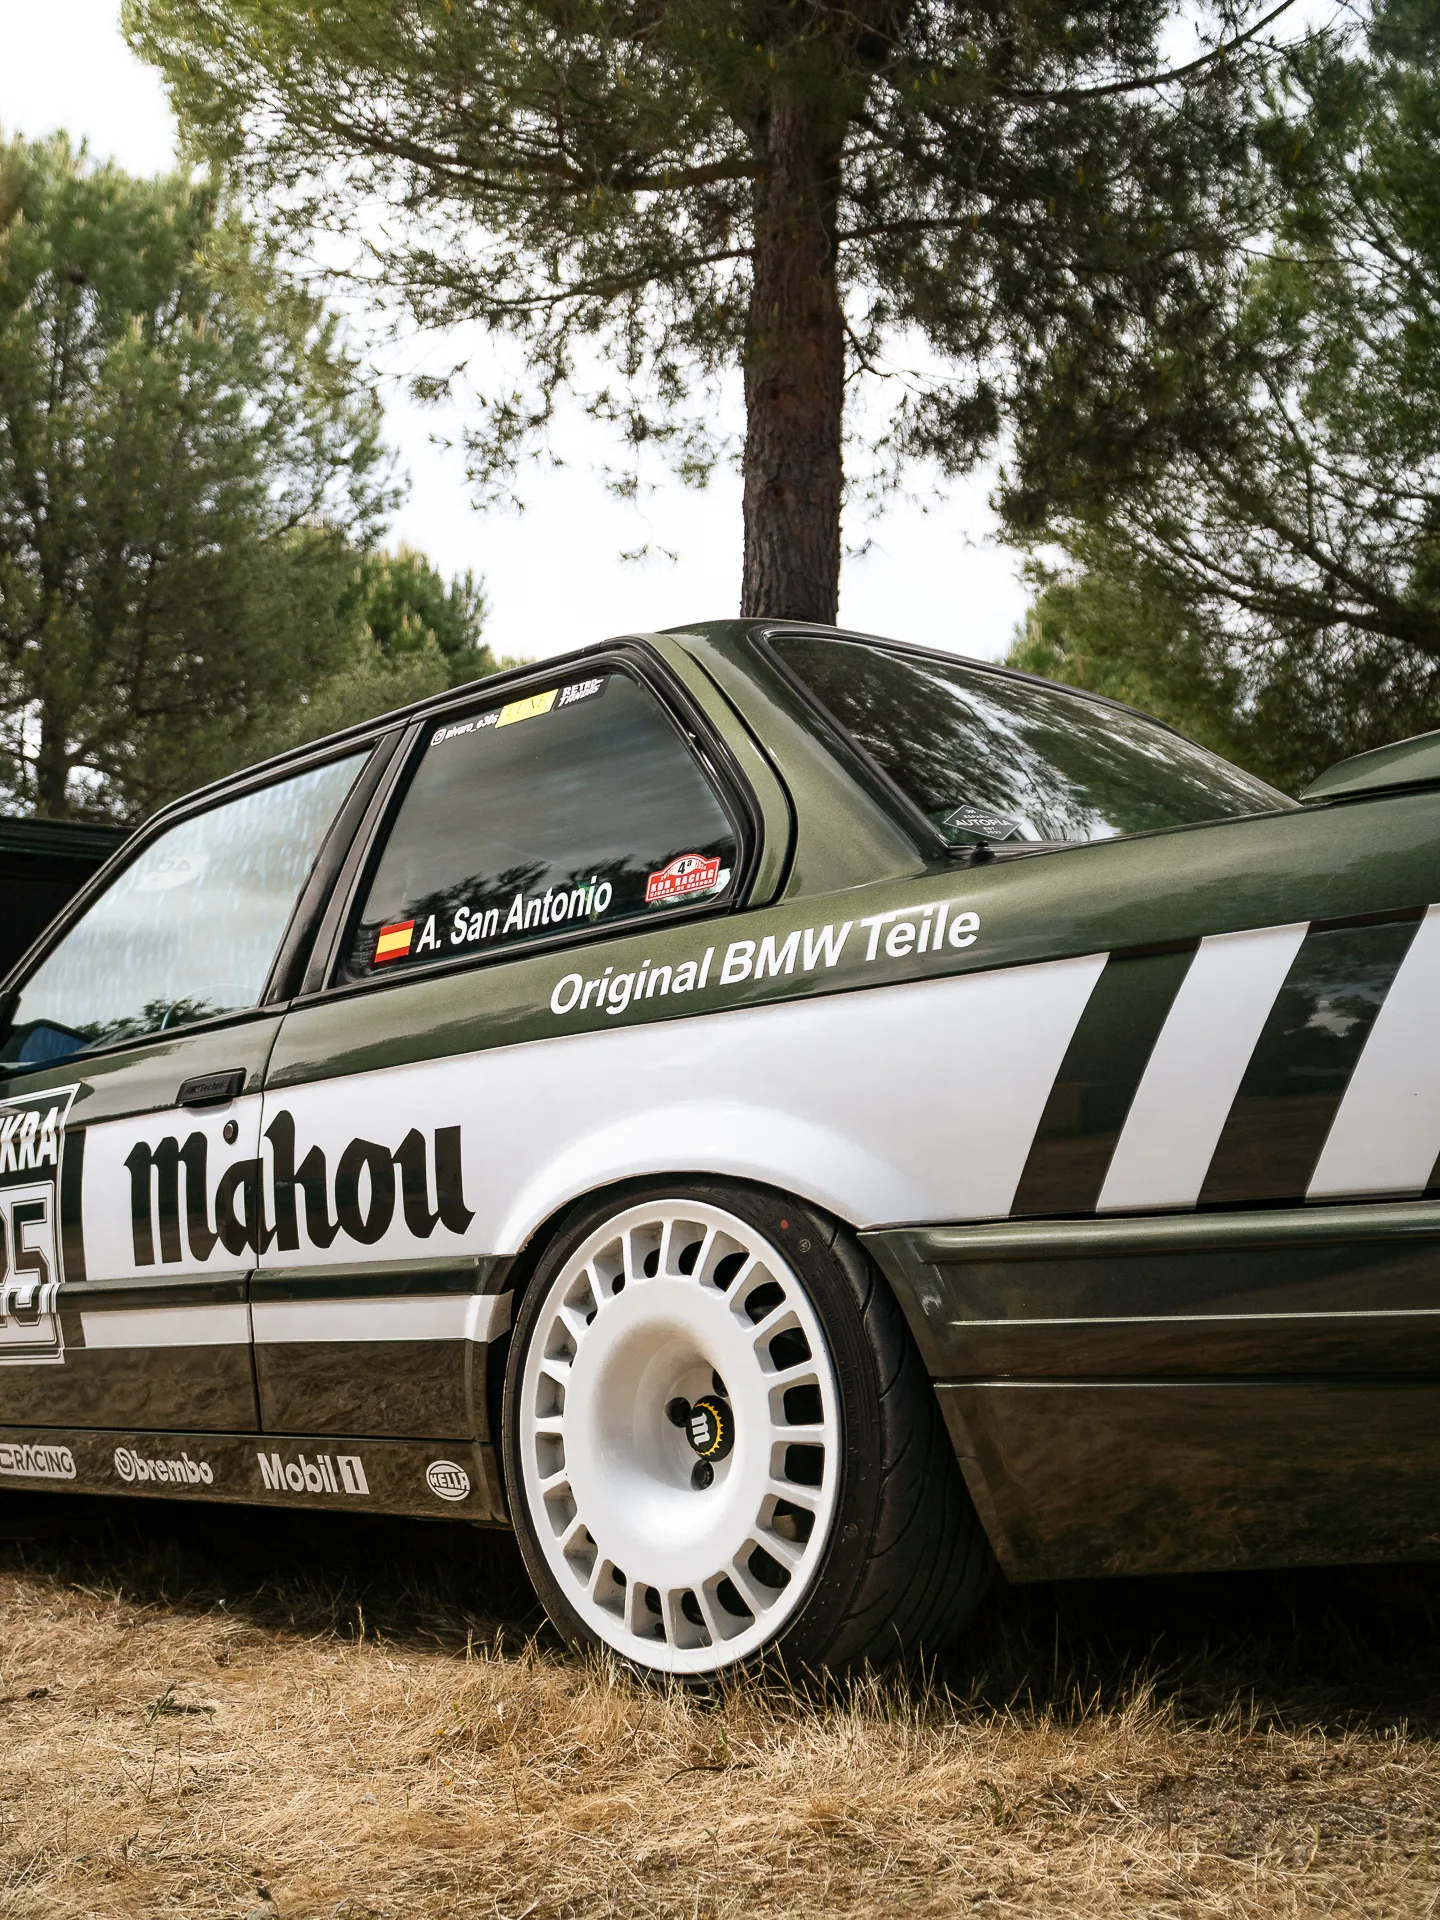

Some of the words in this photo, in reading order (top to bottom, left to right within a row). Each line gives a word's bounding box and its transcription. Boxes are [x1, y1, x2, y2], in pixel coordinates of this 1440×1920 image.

[675, 869, 714, 887] RACING
[416, 914, 441, 953] A.
[450, 906, 500, 945] San
[502, 875, 613, 934] Antonio
[550, 945, 715, 1016] Original
[719, 920, 855, 986] BMW
[857, 903, 981, 962] Teile
[0, 1107, 58, 1174] KRA
[130, 1449, 214, 1485] brembo
[257, 1452, 339, 1493] Mobil
[430, 1472, 471, 1491] HELLA
